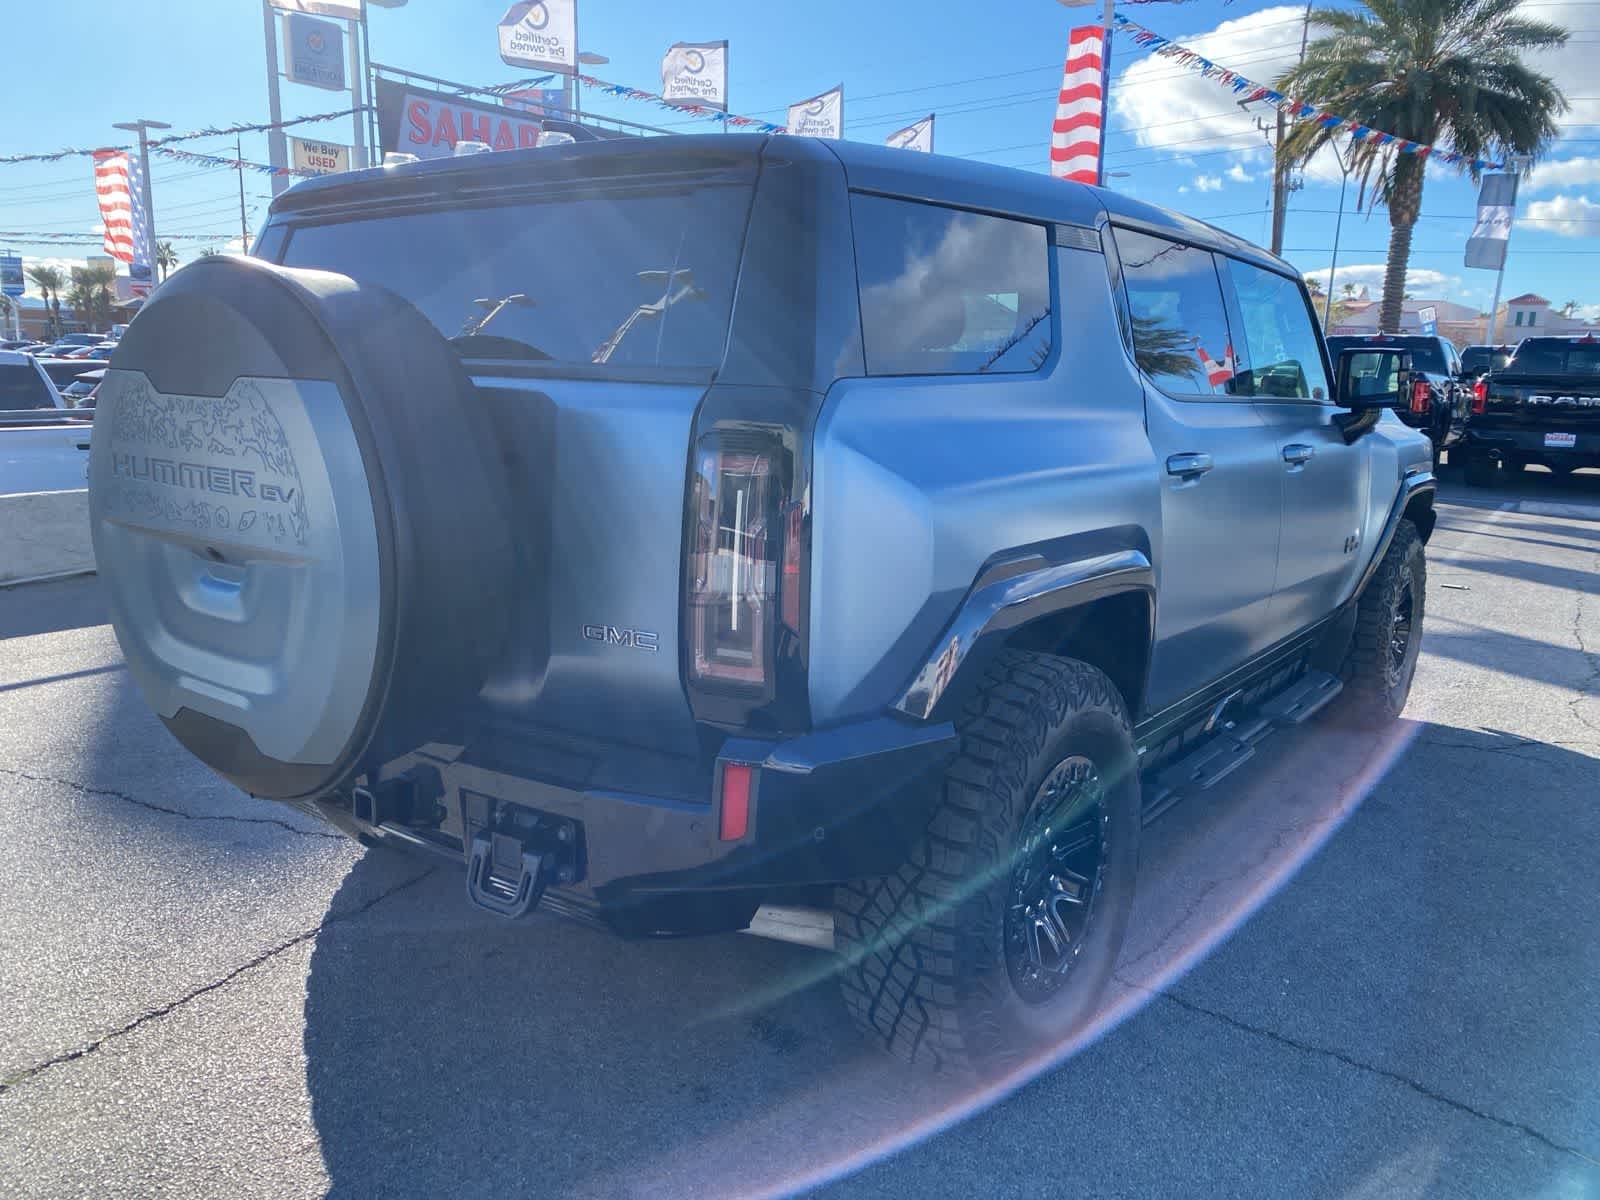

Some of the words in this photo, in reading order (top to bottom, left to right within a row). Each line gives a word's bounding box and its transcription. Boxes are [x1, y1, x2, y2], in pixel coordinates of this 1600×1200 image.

[303, 141, 318, 153] We
[321, 144, 339, 158] Buy
[308, 155, 336, 168] USED
[111, 453, 258, 498] HUMMER
[260, 484, 295, 502] EV
[582, 623, 659, 651] GMC
